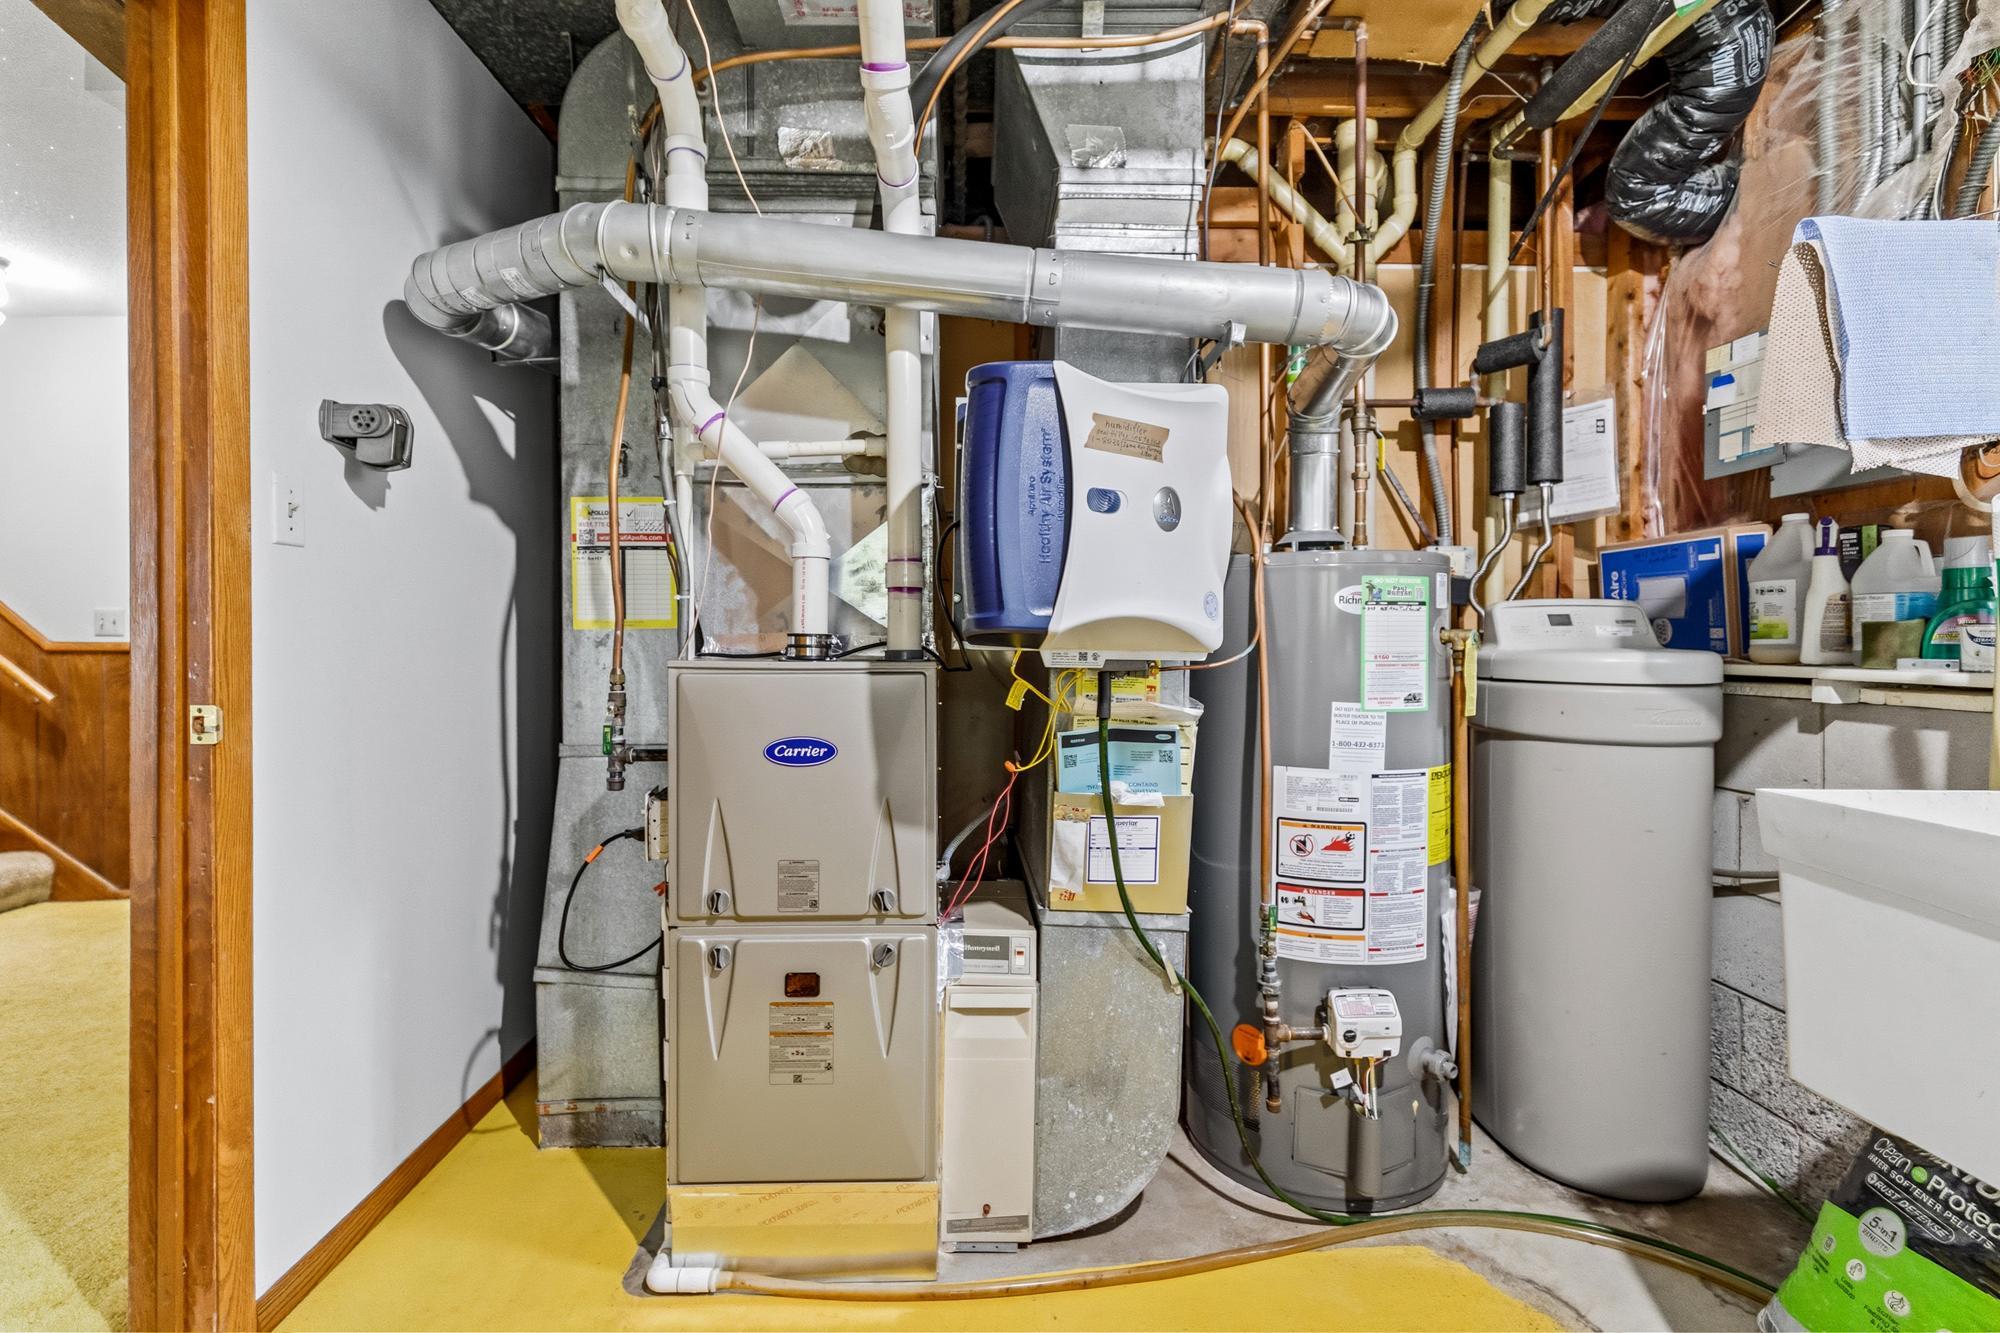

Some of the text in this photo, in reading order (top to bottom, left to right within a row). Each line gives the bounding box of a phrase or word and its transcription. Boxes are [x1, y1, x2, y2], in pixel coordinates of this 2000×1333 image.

[1039, 511, 1055, 564] Healthy
[774, 745, 828, 757] Carrier
[1114, 820, 1138, 829] uperior
[1874, 1138, 1913, 1174] Clean
[1874, 1178, 1951, 1238] RUST DEFENSE
[1889, 1169, 1942, 1213] SOFTENER
[1943, 1210, 1996, 1251] PELLETS
[1868, 1216, 1898, 1243] 5-in-1
